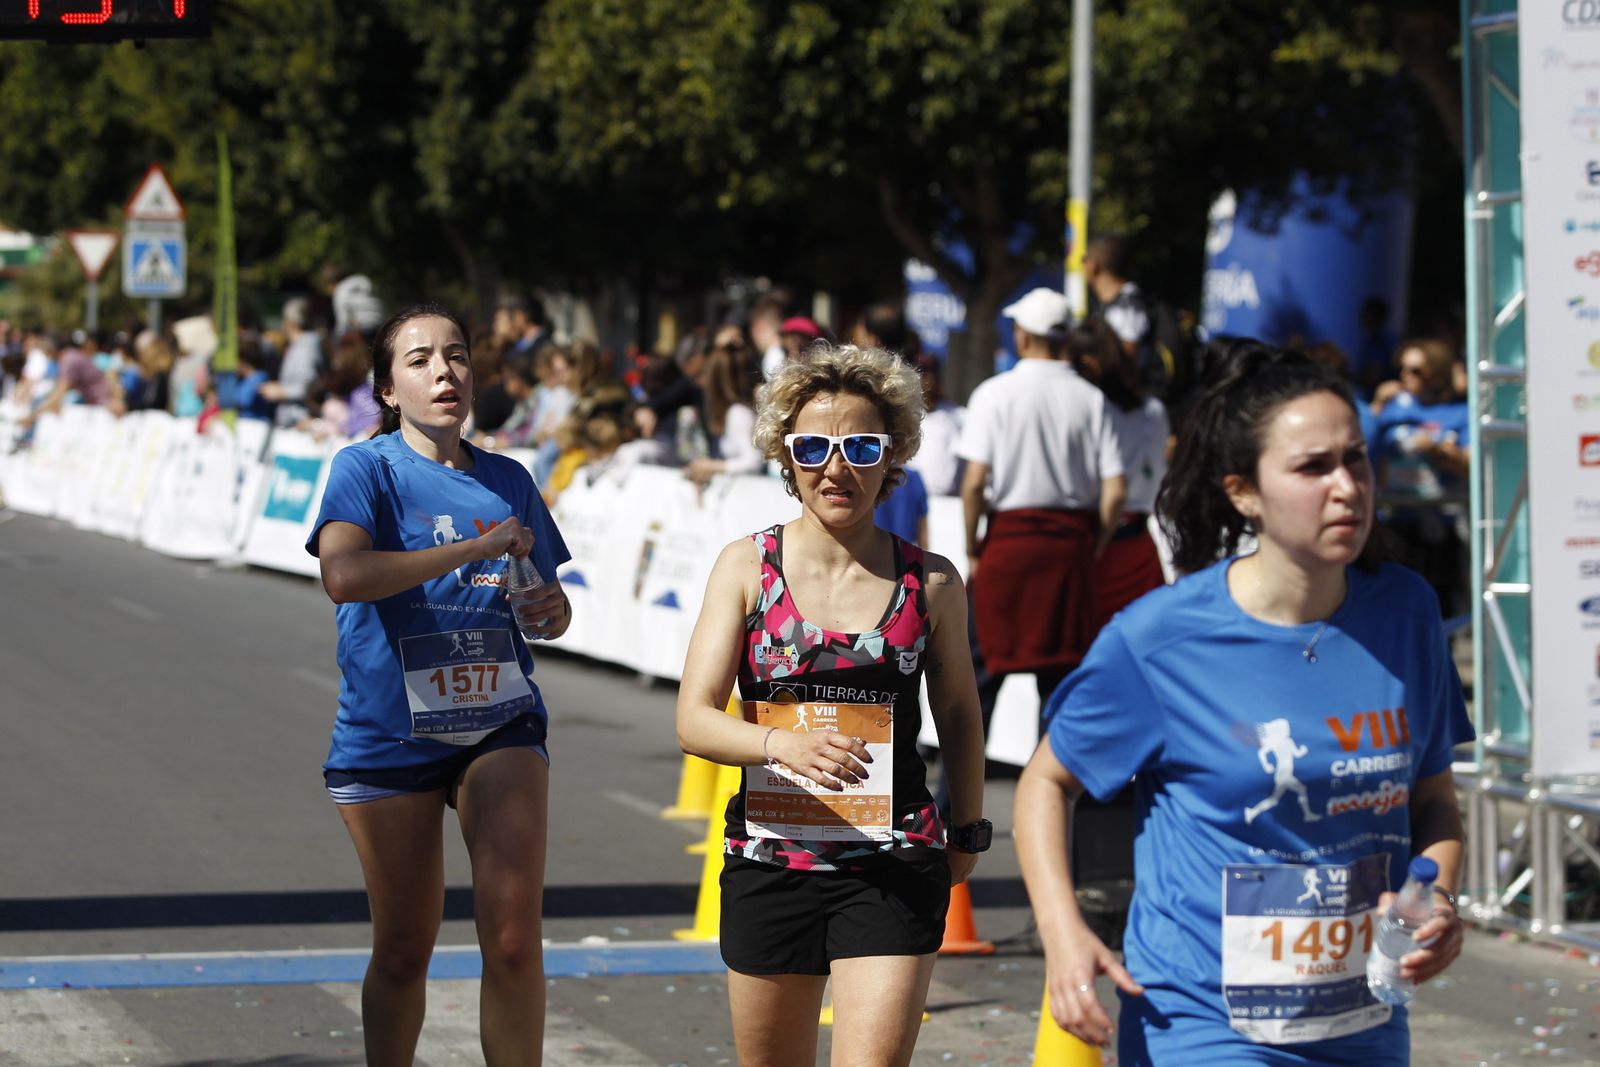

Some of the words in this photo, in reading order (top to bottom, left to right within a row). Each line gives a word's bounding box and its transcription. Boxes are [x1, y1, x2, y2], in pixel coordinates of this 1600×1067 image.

[1562, 0, 1600, 24] CD
[423, 602, 464, 612] IGUALDAD
[465, 632, 483, 640] VIII
[430, 664, 499, 696] 1577
[452, 694, 490, 704] CRISTINA
[812, 684, 877, 702] TIERRAS
[879, 691, 899, 704] DE
[813, 706, 837, 716] VIII
[1325, 707, 1409, 752] VIII
[767, 776, 812, 788] ESCUELA
[1261, 912, 1373, 961] 1491
[1296, 962, 1348, 976] RAQUEL
